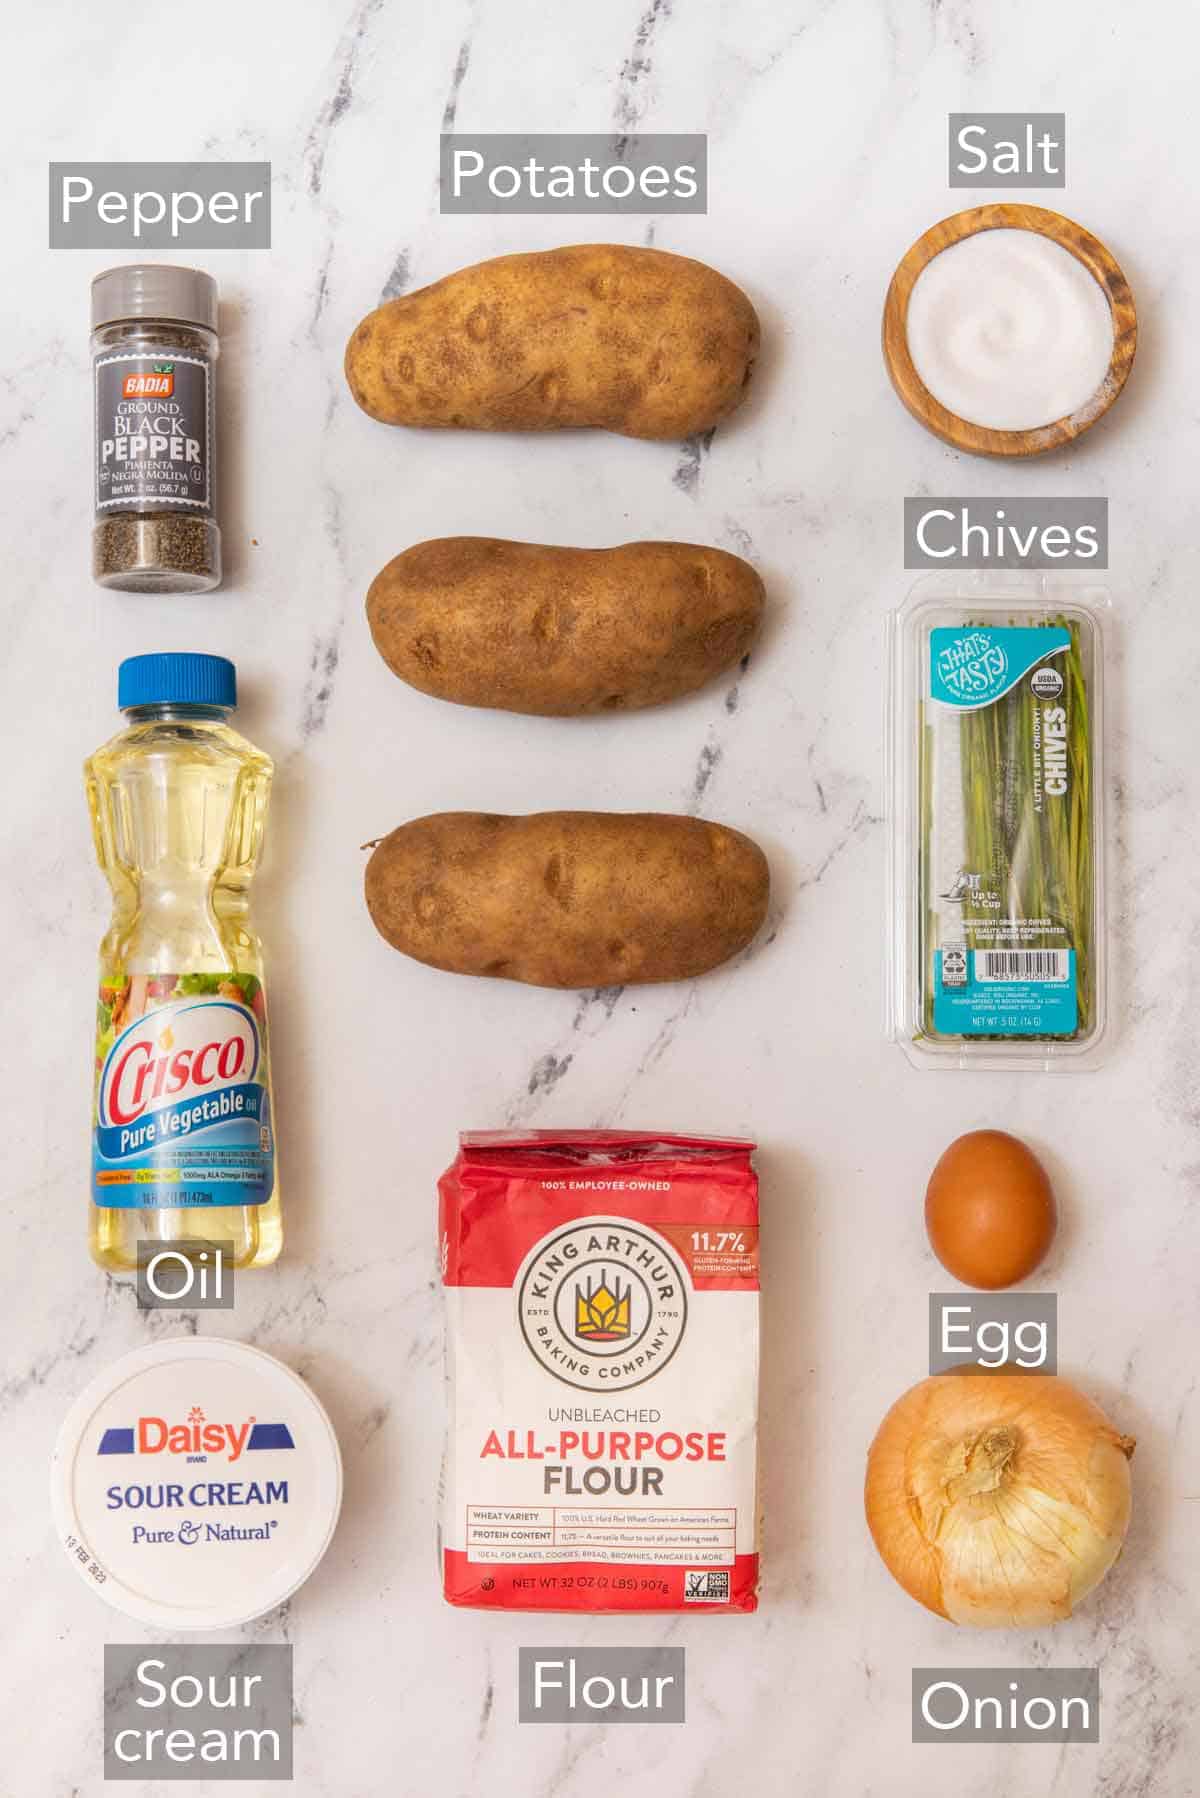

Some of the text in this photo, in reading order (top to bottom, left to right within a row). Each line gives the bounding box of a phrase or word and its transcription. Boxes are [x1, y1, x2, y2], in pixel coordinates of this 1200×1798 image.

[126, 378, 169, 393] BADIA
[117, 402, 180, 414] GROUND
[113, 415, 188, 436] BLACK
[102, 435, 201, 464] PEPPER
[111, 470, 144, 481] NEGRA
[146, 470, 188, 481] MOLIDA
[124, 461, 173, 470] PIMIENTA
[940, 632, 991, 670] THAT'S
[944, 645, 1004, 692] TASTY
[1043, 706, 1067, 796] CHIVES
[1033, 771, 1042, 803] LITTLE
[1033, 805, 1042, 813] A
[972, 891, 985, 902] Up
[982, 900, 1000, 909] Cup
[972, 1016, 986, 1026] NET
[109, 1036, 246, 1125] Crisco
[120, 1122, 156, 1153] Pure
[158, 1089, 245, 1135] Vegetable
[541, 1180, 671, 1192] 100% EMPLOYEE-OWNED
[691, 1231, 745, 1253] 11.7%
[531, 1234, 675, 1301] KING ARTHUR
[537, 1326, 670, 1379] BAKING COMPANY
[548, 1407, 661, 1424] UNBLEACHED
[138, 1408, 251, 1463] Daisy
[479, 1429, 727, 1462] ALL-PURPOSE
[543, 1465, 665, 1496] FLOUR
[106, 1480, 289, 1510] SOUR CREAM
[473, 1511, 540, 1521] WHEAT VARIETY
[132, 1520, 270, 1546] Pure & Natural
[473, 1530, 552, 1540] PROTEIN CONTENT
[75, 1545, 90, 1564] FEB
[477, 1551, 499, 1559] IDEAL
[500, 1551, 516, 1559] FOR
[654, 1552, 693, 1561] PANCAKES
[512, 1576, 670, 1594] NET WT 32 OZ (2 LBS) 907g
